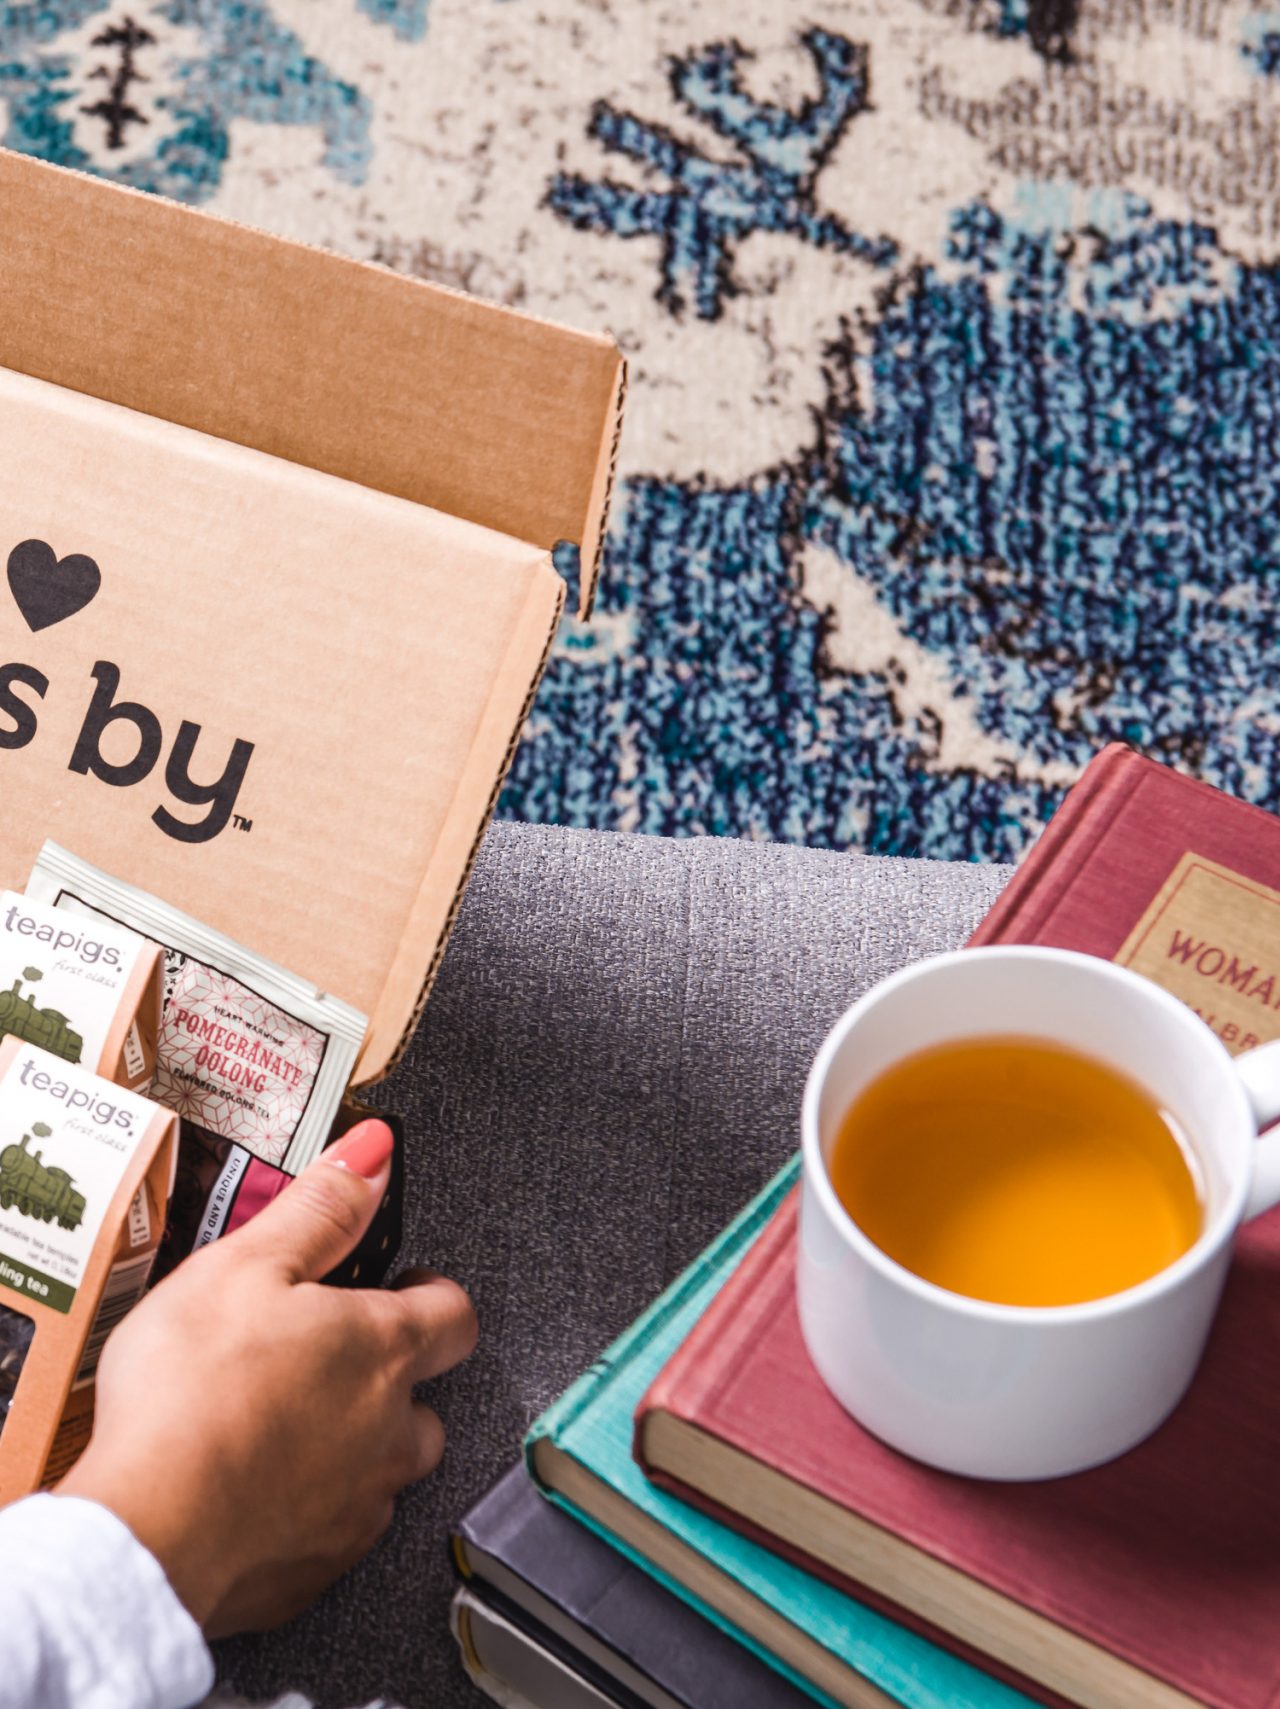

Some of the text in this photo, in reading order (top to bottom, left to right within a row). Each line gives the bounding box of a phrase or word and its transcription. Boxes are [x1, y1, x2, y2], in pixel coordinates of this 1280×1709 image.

[68, 660, 255, 844] by
[52, 959, 119, 989] first class
[1168, 929, 1280, 1011] WOMA
[173, 1008, 303, 1087] POMEGRANATE
[213, 1006, 285, 1047] HEART WARMING
[174, 1067, 270, 1119] FLAVORED OOLONG TEA
[195, 1045, 267, 1093] OOLONG
[201, 1158, 241, 1247] UNIQUE AND UN
[27, 1276, 49, 1297] tea
